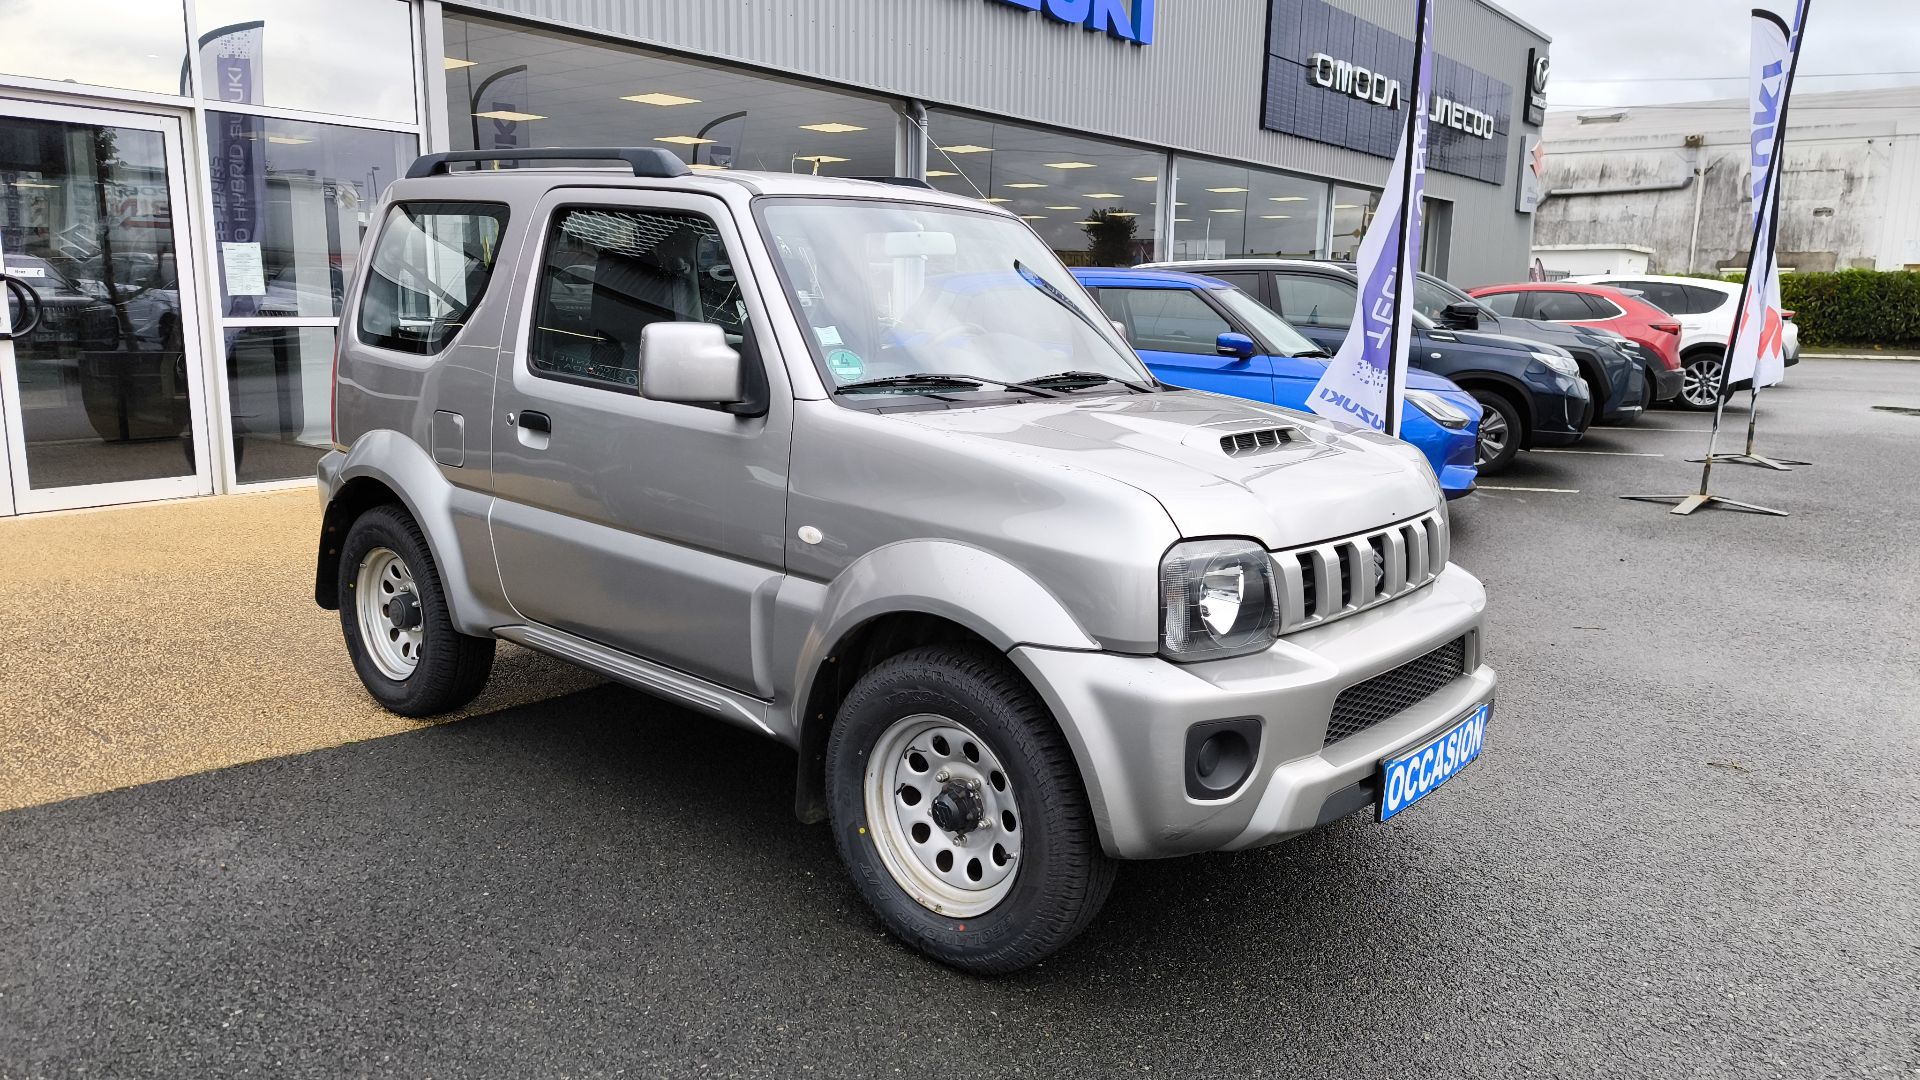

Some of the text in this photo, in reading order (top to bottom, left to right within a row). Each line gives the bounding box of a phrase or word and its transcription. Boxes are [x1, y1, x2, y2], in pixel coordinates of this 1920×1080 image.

[1311, 53, 1401, 110] OMODA
[1429, 96, 1494, 139] JAECOO
[841, 353, 850, 366] 4
[1388, 710, 1485, 811] OCCASION
